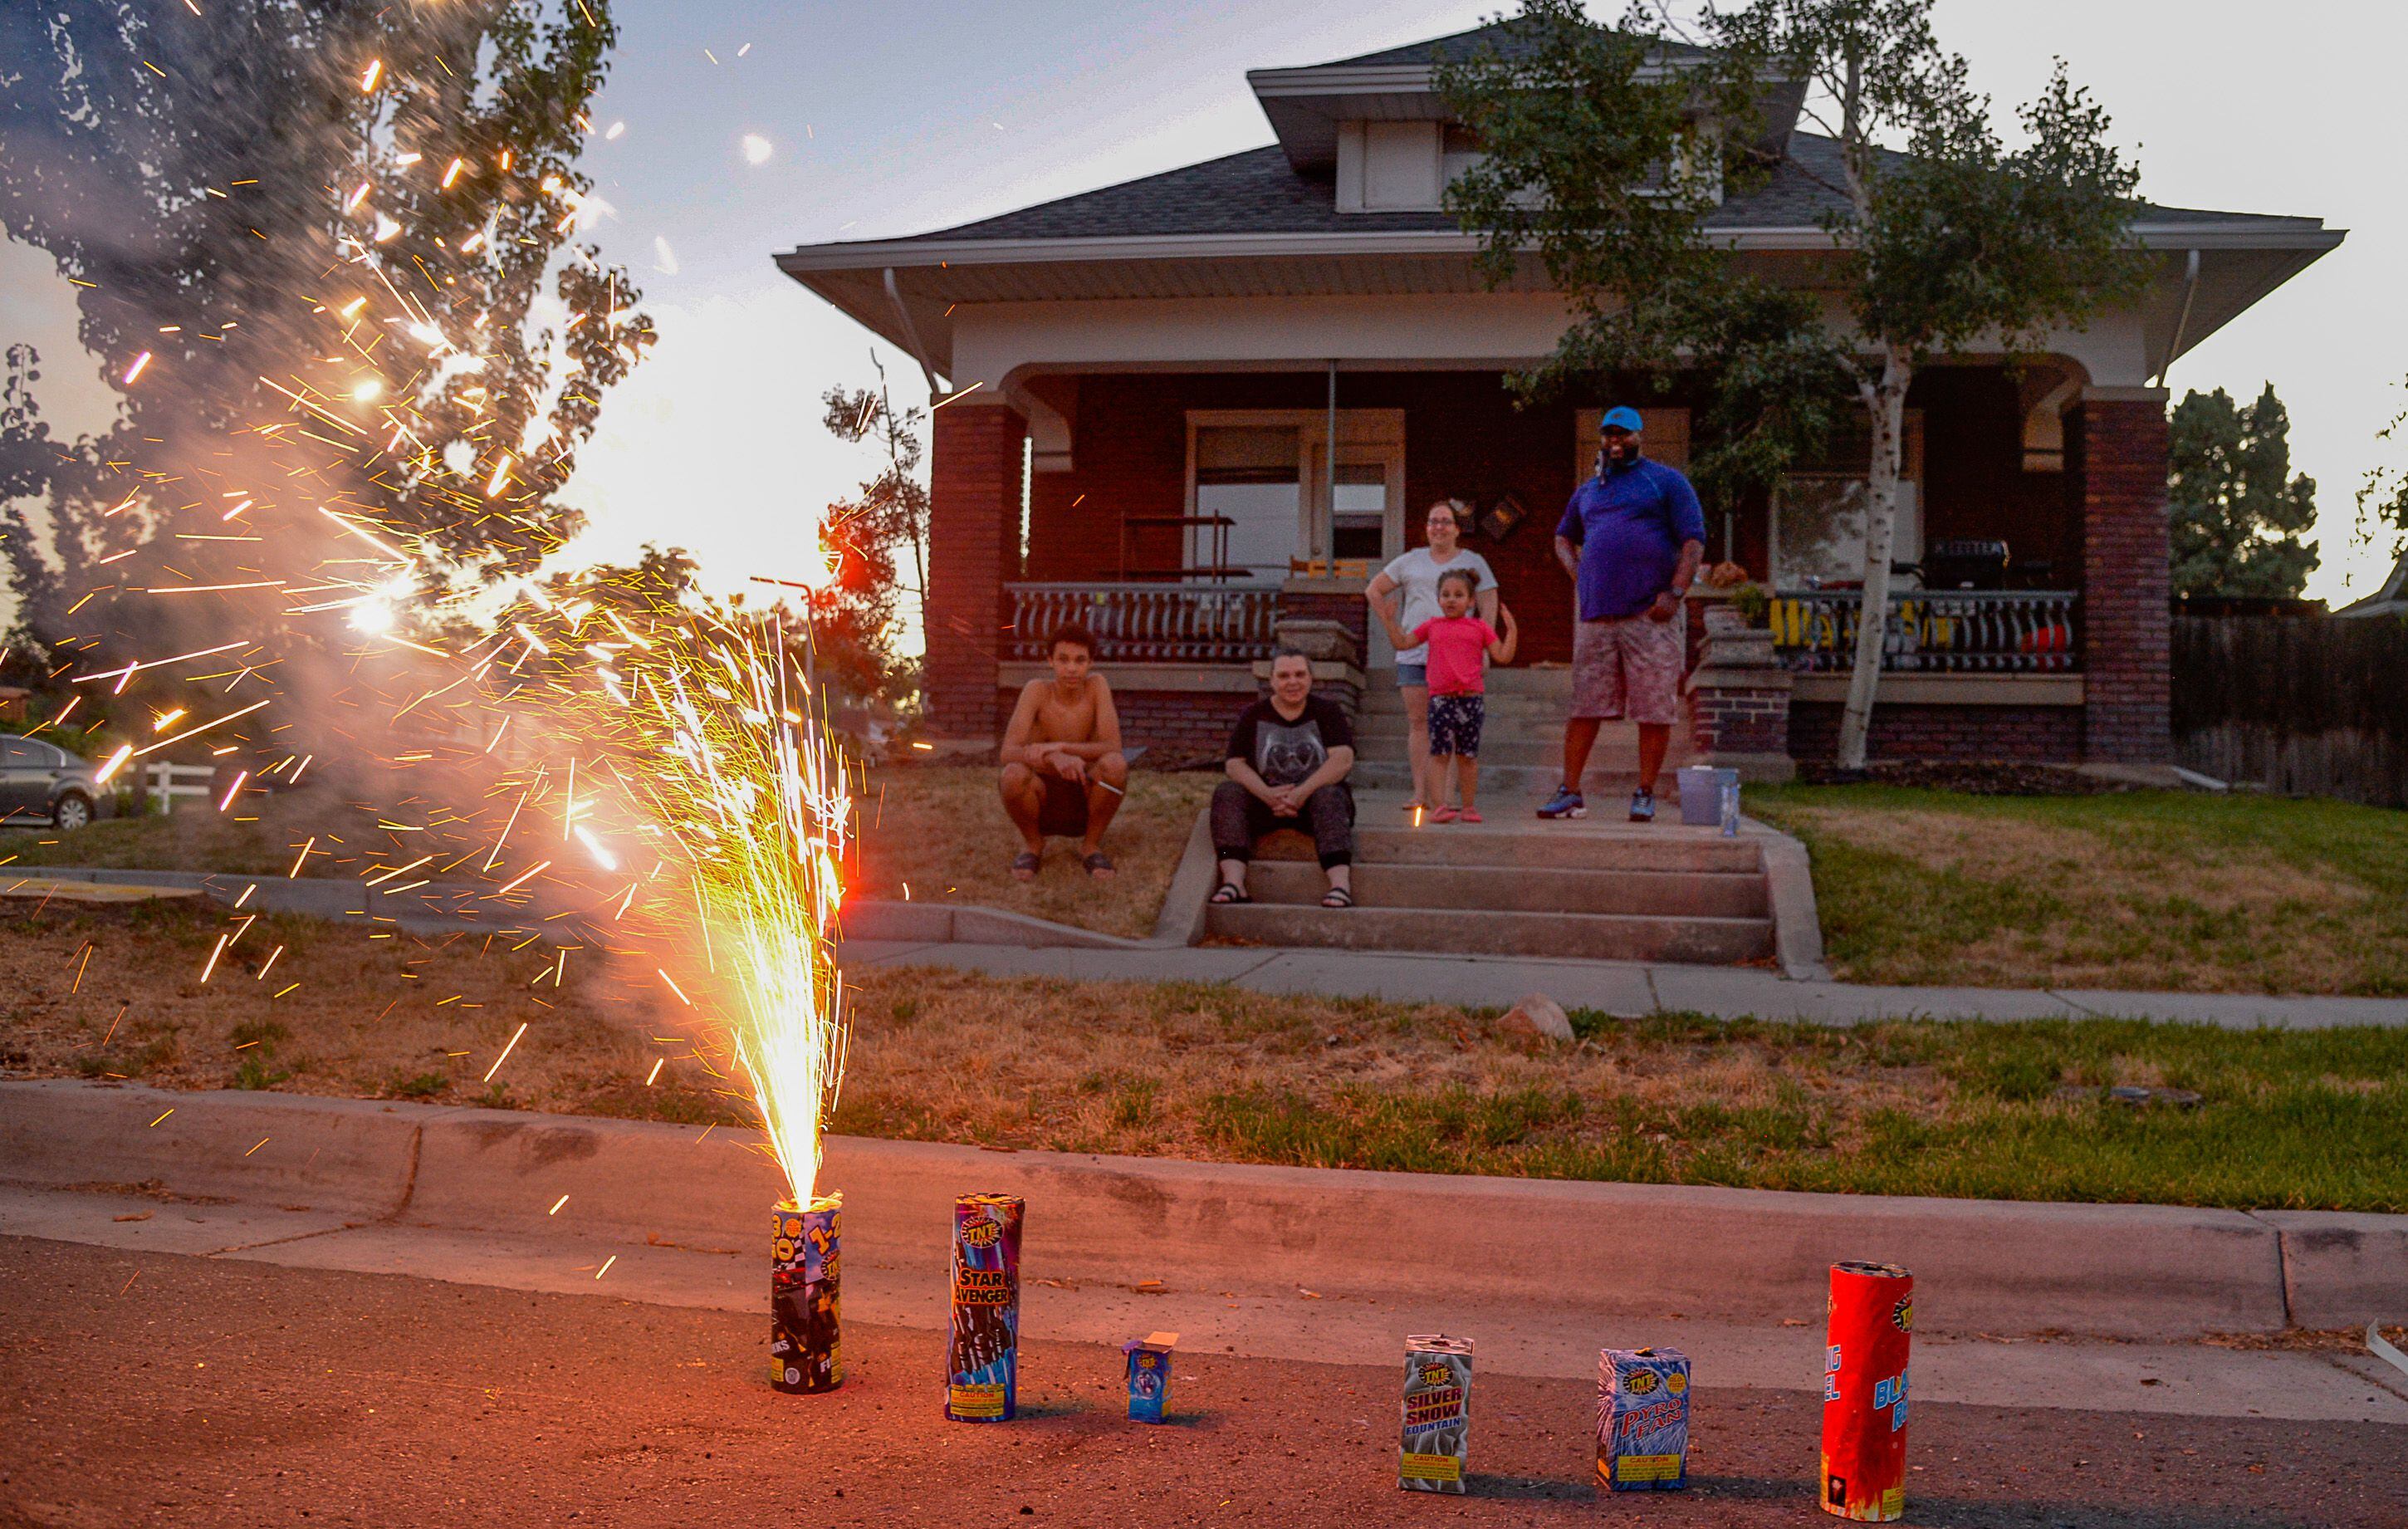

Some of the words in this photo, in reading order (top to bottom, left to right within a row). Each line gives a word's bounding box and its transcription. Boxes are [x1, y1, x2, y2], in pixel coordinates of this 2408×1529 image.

[968, 1223, 996, 1242] TNT
[960, 1269, 1003, 1286] STAR
[956, 1286, 1008, 1303] AVENGER
[1424, 1368, 1448, 1383] TNT
[1629, 1374, 1654, 1391] TNT
[1407, 1388, 1462, 1410] SILVER
[1407, 1403, 1461, 1425] SNOW
[1621, 1399, 1681, 1438] PYRO
[1406, 1418, 1461, 1435] FOUNTAIN
[1636, 1409, 1681, 1439] FAN
